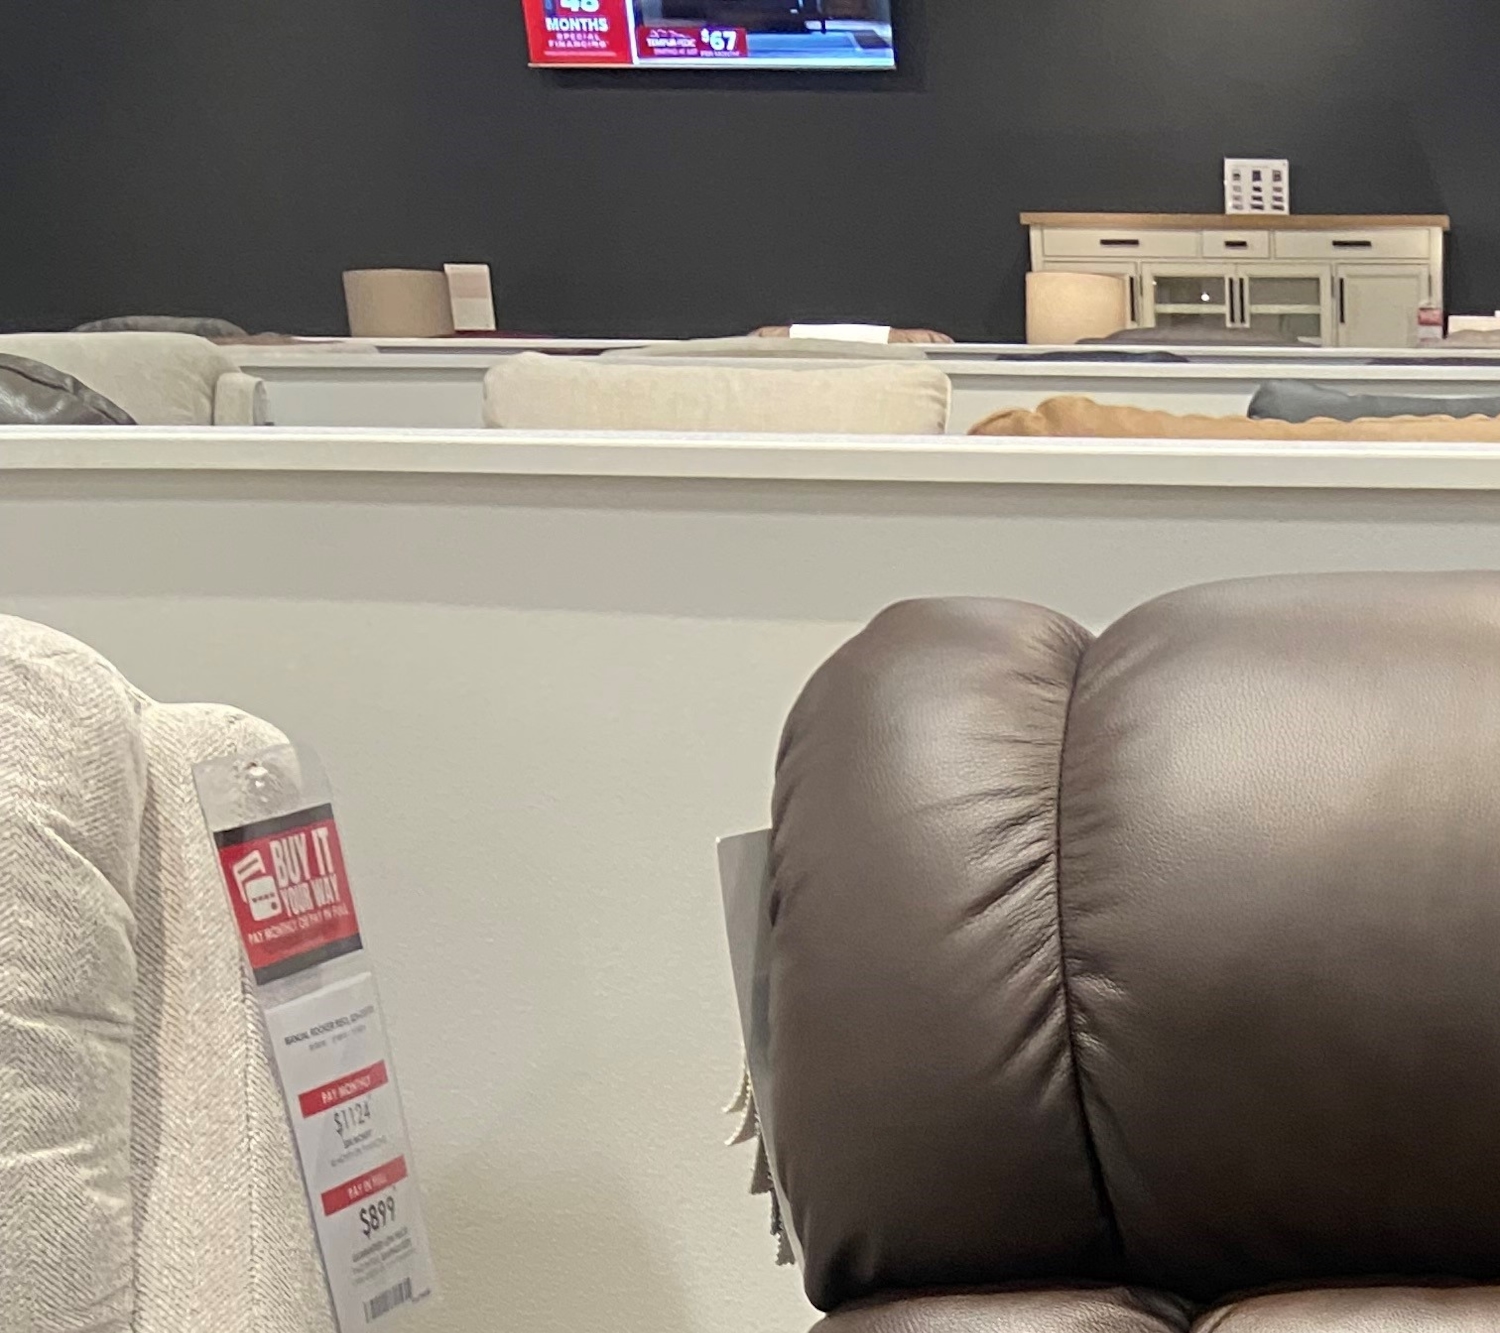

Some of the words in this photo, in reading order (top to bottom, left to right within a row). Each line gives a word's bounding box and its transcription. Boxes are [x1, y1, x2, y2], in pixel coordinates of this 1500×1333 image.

[545, 17, 609, 32] MONTHS
[701, 28, 737, 51] $67
[270, 832, 310, 888] BUY
[311, 827, 334, 876] IT
[280, 882, 314, 917] YOUR
[310, 873, 341, 907] WAY
[248, 931, 263, 945] PAY
[321, 1089, 338, 1104] PAY
[347, 1184, 363, 1200] PAY
[360, 1196, 396, 1240] $899
